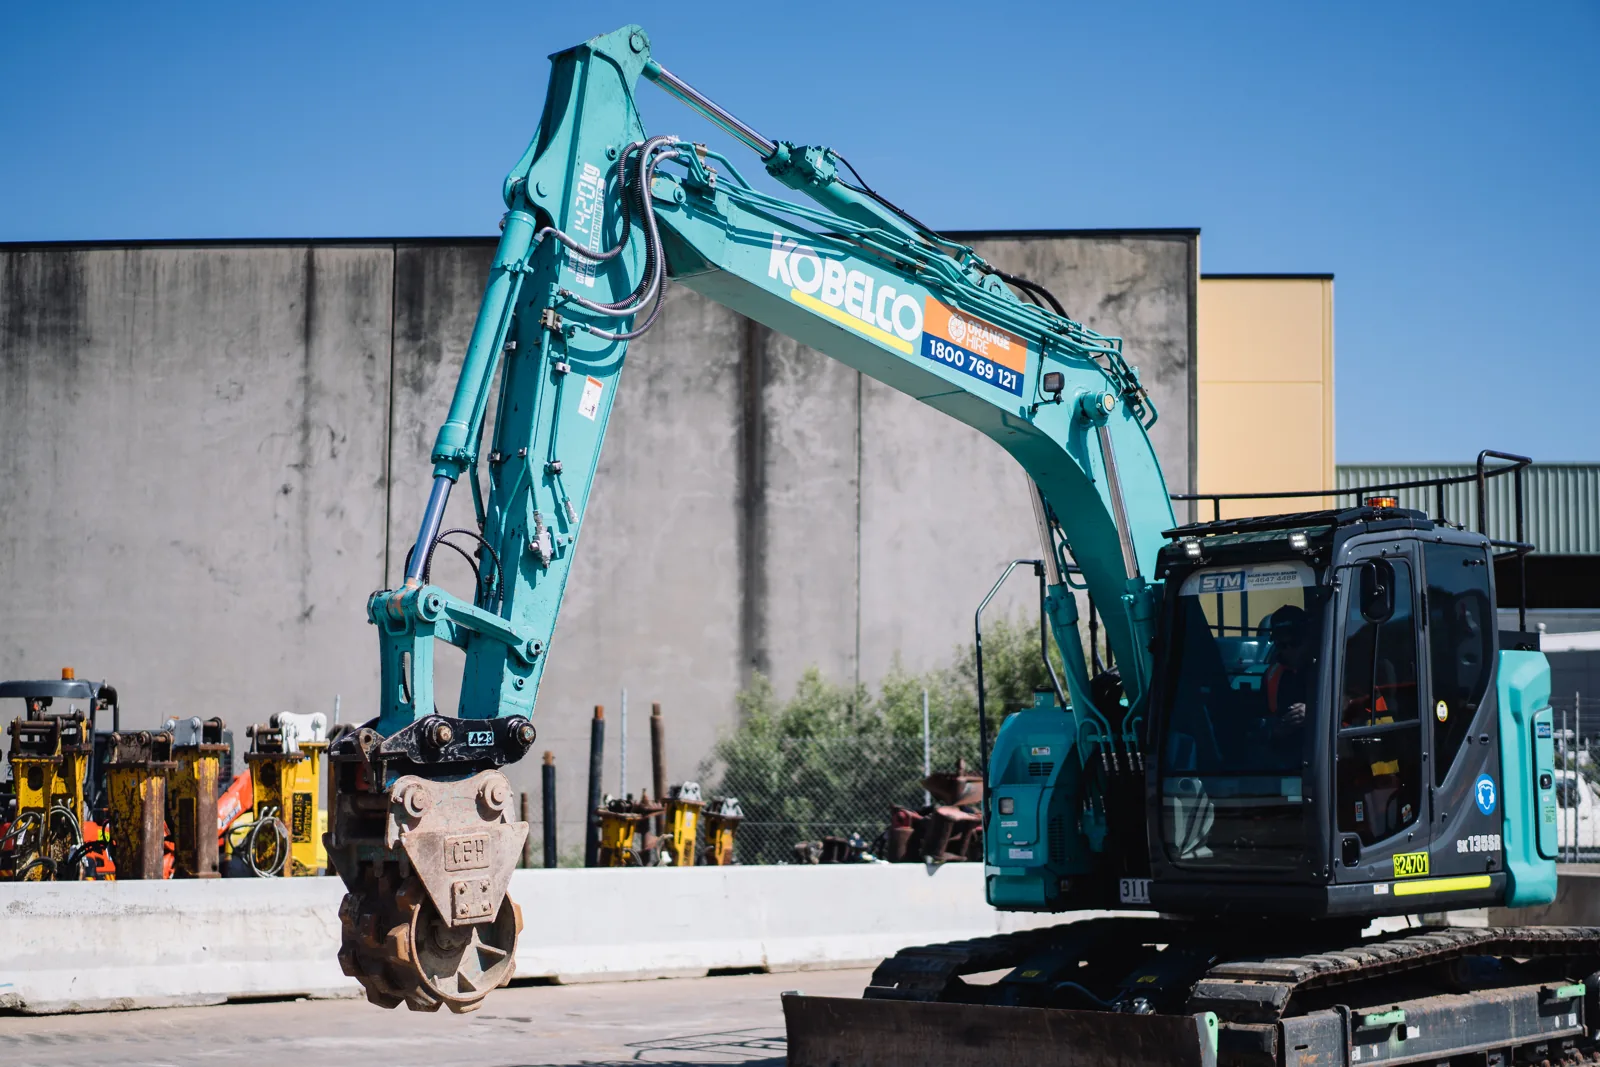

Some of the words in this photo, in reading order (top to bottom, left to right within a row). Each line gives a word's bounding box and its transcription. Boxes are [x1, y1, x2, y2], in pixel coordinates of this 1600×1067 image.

[768, 231, 924, 342] KOBELCO
[966, 334, 989, 356] HIRE
[967, 320, 1011, 351] ORANGE
[929, 339, 965, 367] 1800
[968, 355, 994, 380] 769
[997, 368, 1017, 390] 121
[1203, 573, 1241, 588] STM
[1457, 834, 1501, 854] SK135SR
[1400, 854, 1427, 875] 24701
